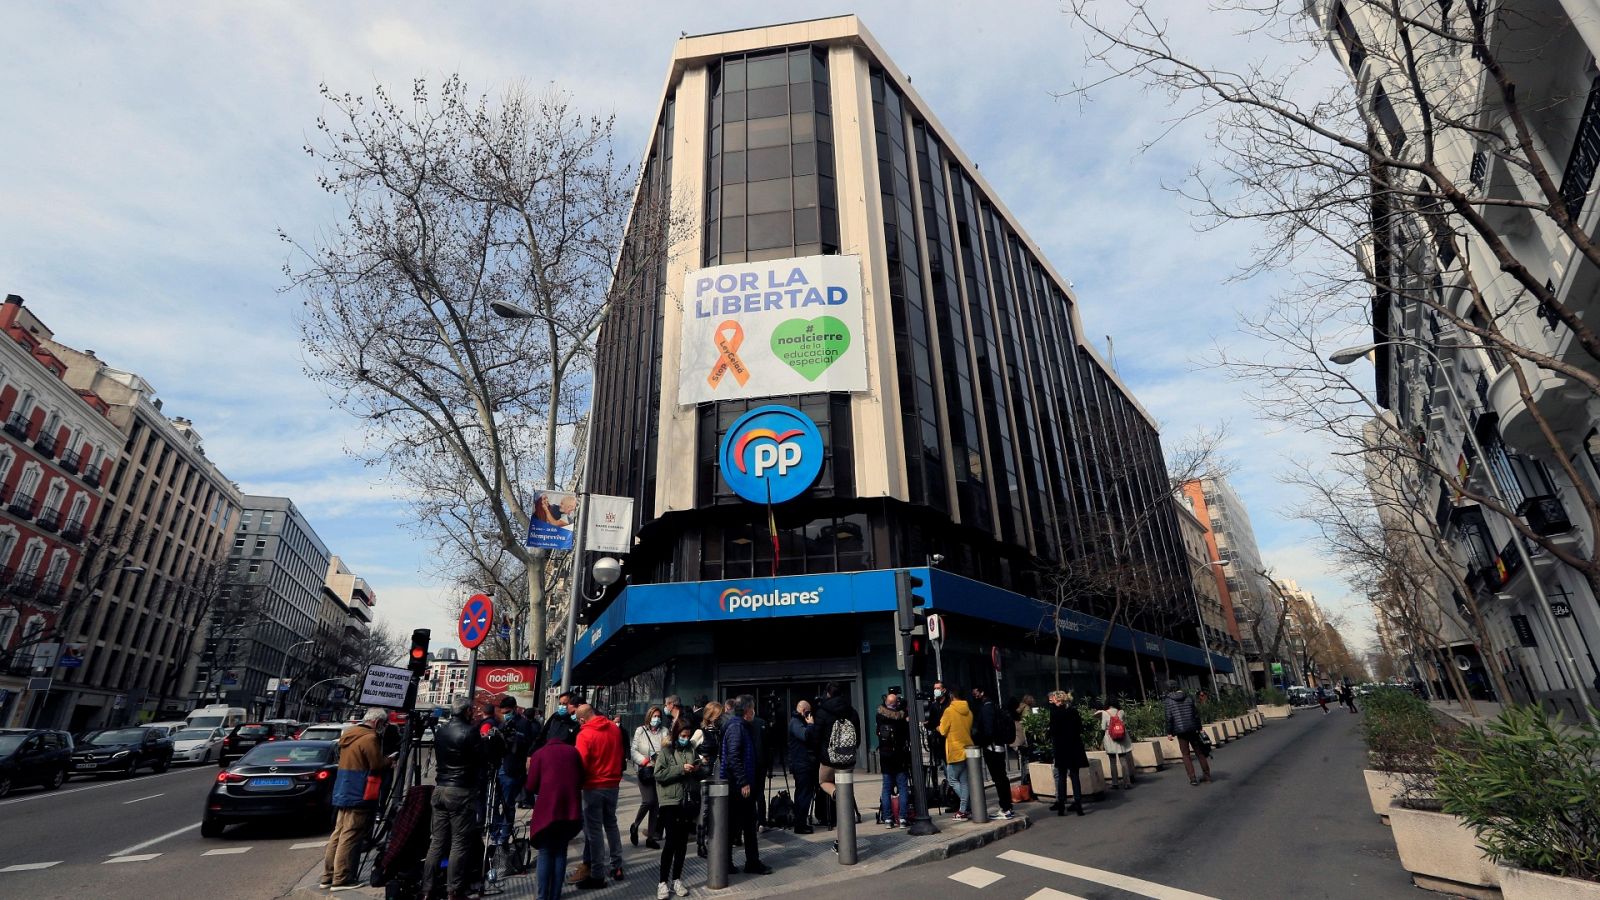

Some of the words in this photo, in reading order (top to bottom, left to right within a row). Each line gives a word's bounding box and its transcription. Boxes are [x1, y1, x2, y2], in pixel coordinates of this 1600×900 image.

[696, 271, 759, 298] POR
[768, 267, 809, 289] LA
[695, 285, 849, 319] LIBERTAD
[778, 333, 843, 345] noalcierre
[783, 347, 839, 359] educación
[789, 355, 834, 367] especial
[712, 363, 727, 382] Stop
[729, 589, 820, 613] populares
[489, 672, 520, 683] nocilla
